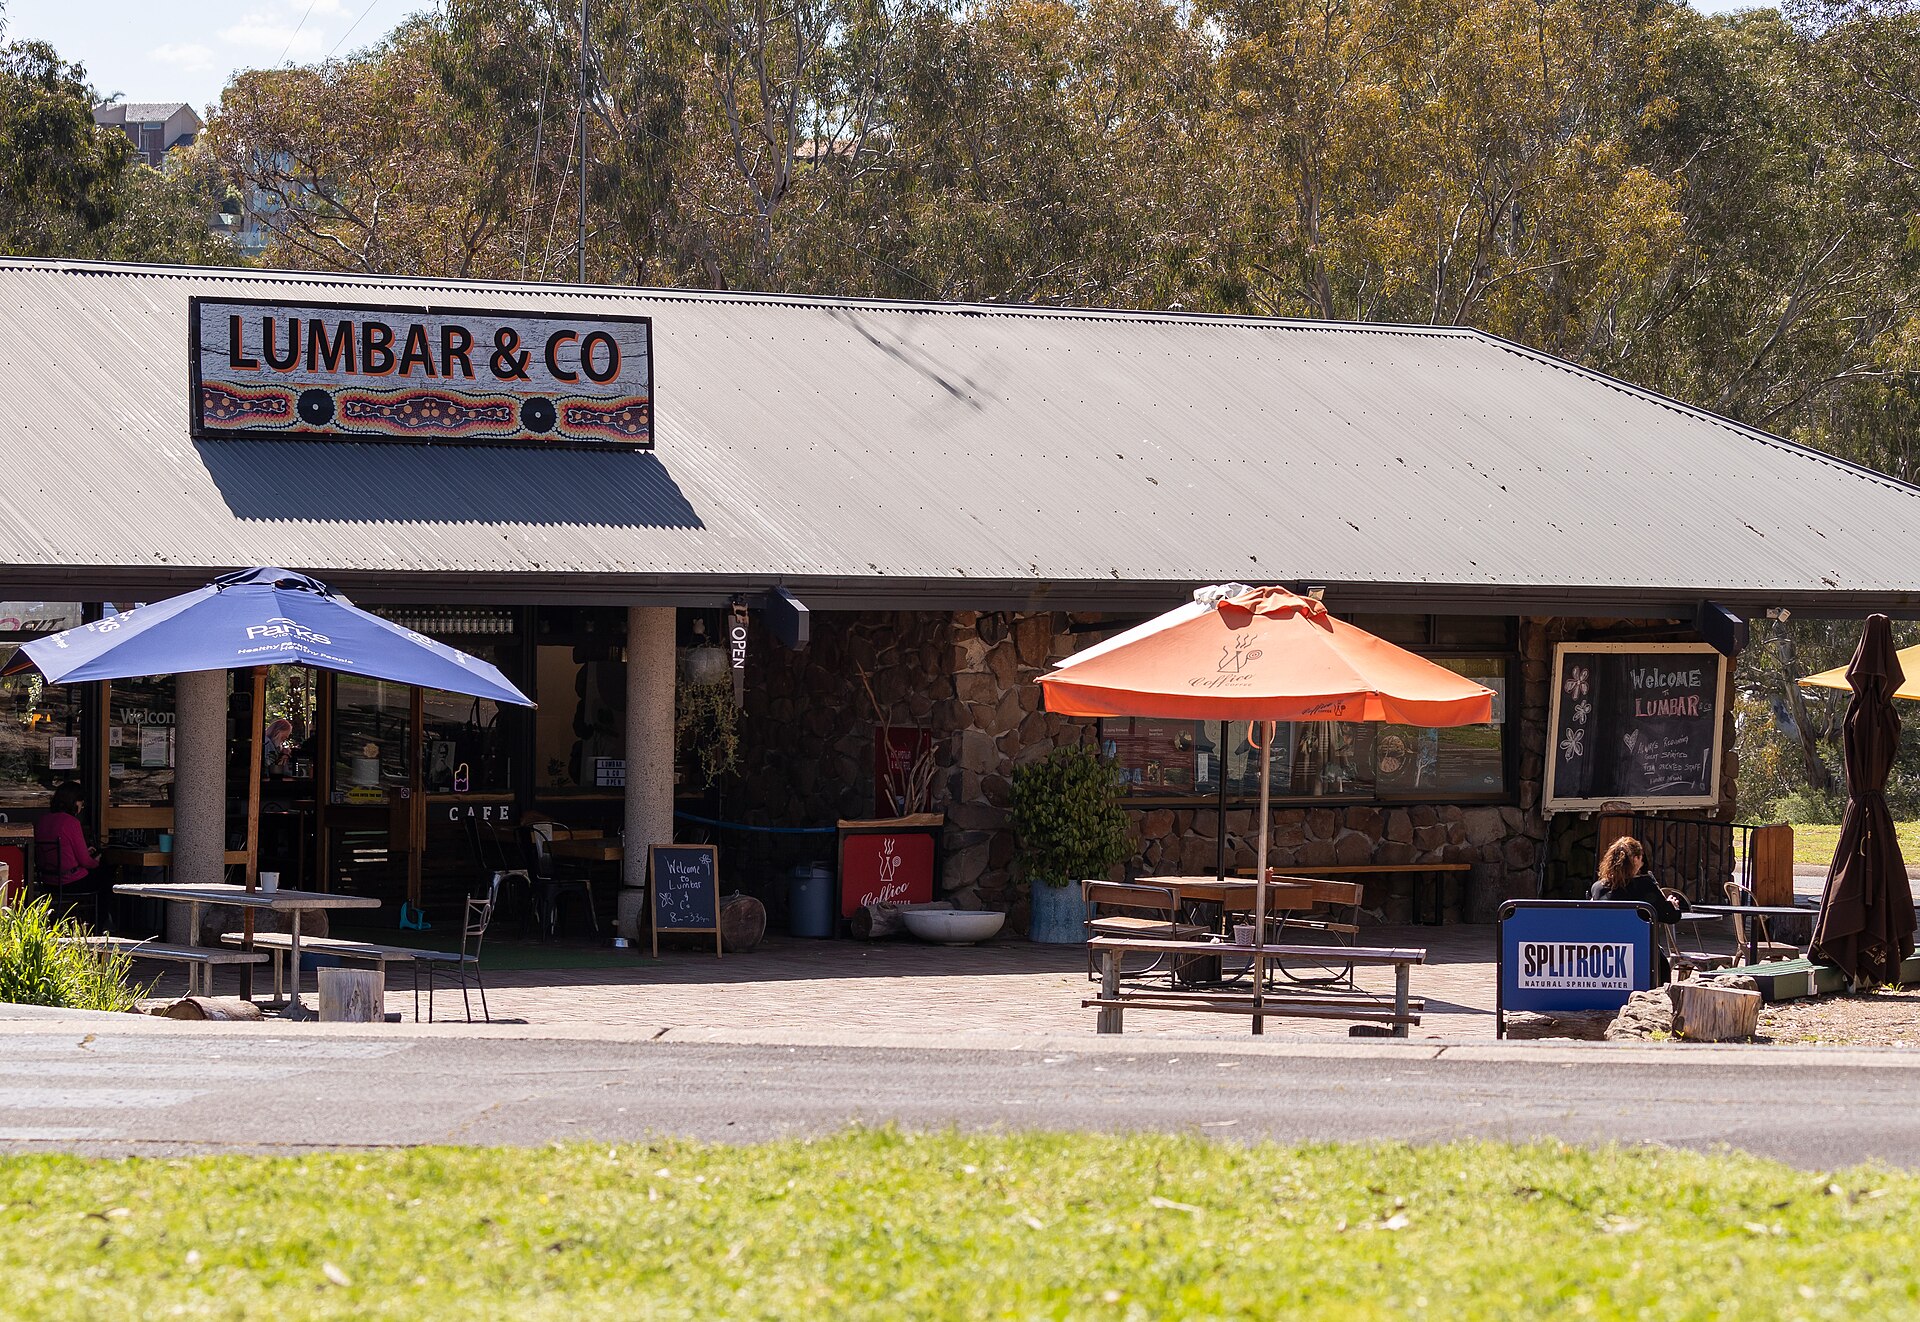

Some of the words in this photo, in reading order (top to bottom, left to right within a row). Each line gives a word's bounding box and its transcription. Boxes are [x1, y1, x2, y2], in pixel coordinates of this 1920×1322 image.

[229, 313, 476, 381] LUMBAR
[489, 325, 531, 382] &
[544, 329, 622, 386] CO
[246, 624, 332, 645] Parks
[237, 643, 280, 655] Healthy
[731, 626, 747, 669] OPEN
[320, 652, 354, 664] People
[1188, 673, 1257, 689] Coffico
[1634, 694, 1699, 717] LUMBAR
[120, 707, 176, 724] Welcom
[449, 805, 509, 821] CAFE
[664, 856, 700, 874] Welcome
[669, 880, 702, 890] Lumbar
[1524, 944, 1628, 979] SPLITROCK
[1525, 980, 1562, 988] NATURAL
[1601, 981, 1628, 989] WATER
